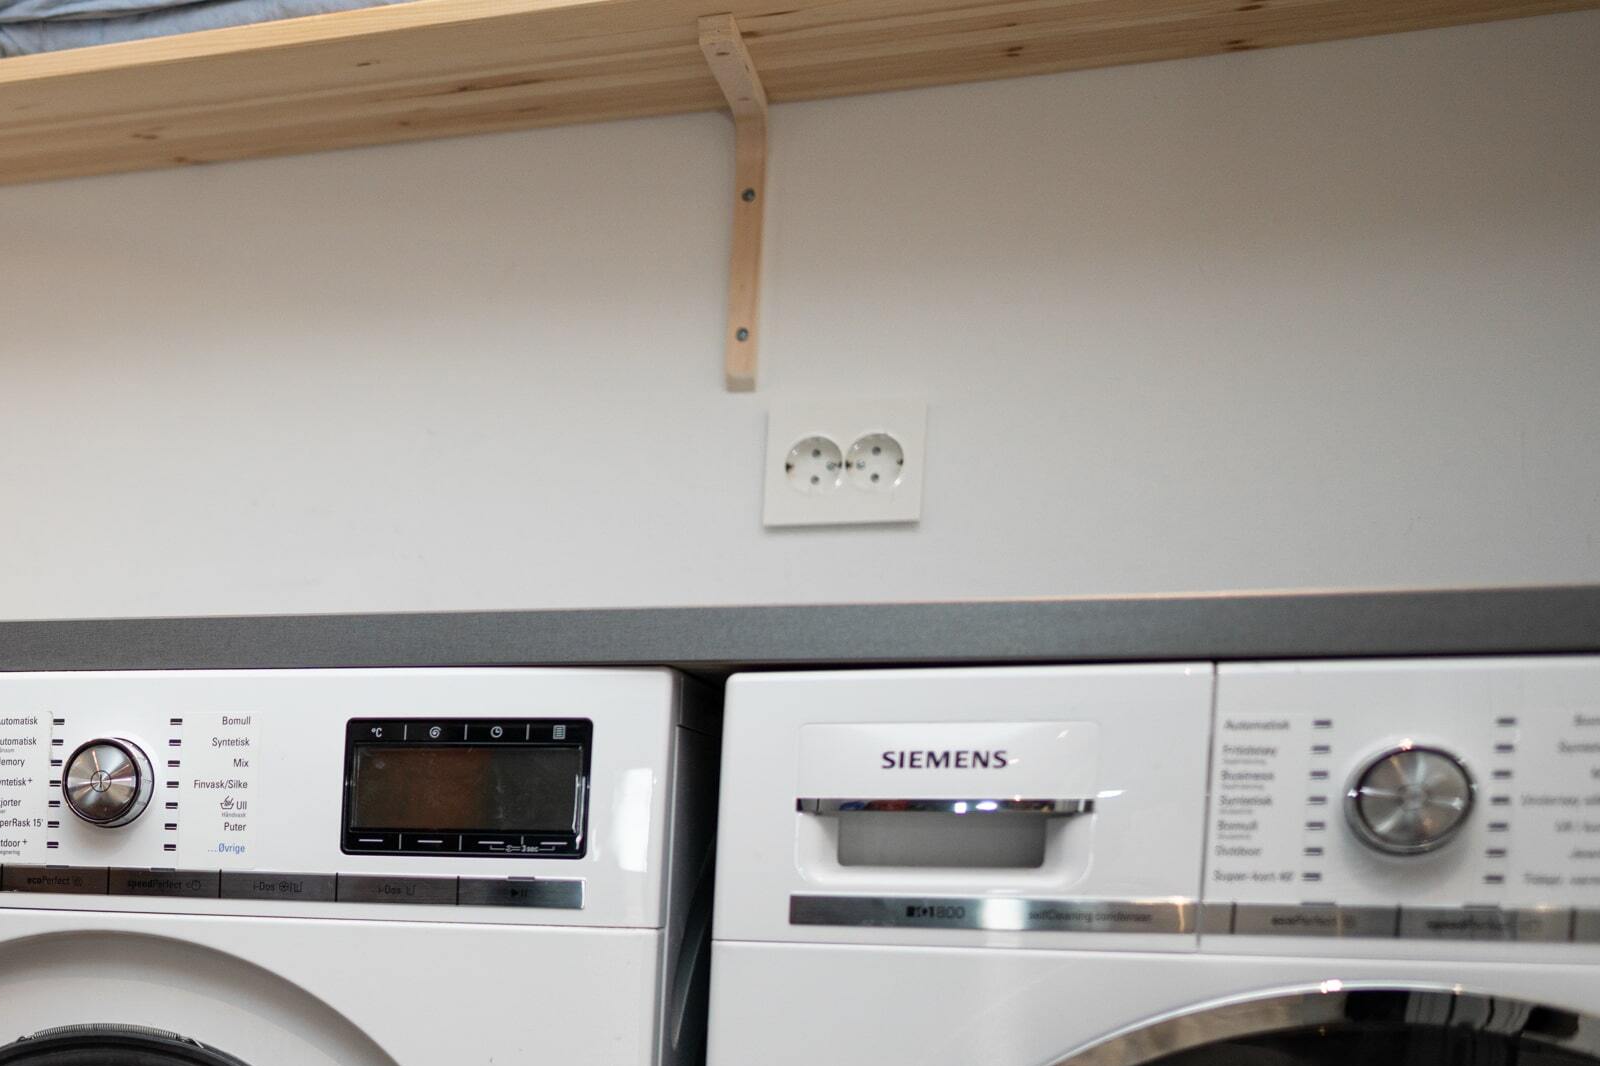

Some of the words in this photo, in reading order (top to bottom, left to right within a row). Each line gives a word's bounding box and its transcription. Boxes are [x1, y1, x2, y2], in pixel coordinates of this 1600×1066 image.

[222, 715, 251, 726] Bomull
[211, 737, 250, 748] Syntetisk
[233, 758, 249, 768] Mix
[882, 751, 1007, 769] SIEMENS
[193, 779, 248, 790] Finvask/Silke
[236, 801, 248, 811] Ull
[223, 821, 247, 832] Puter
